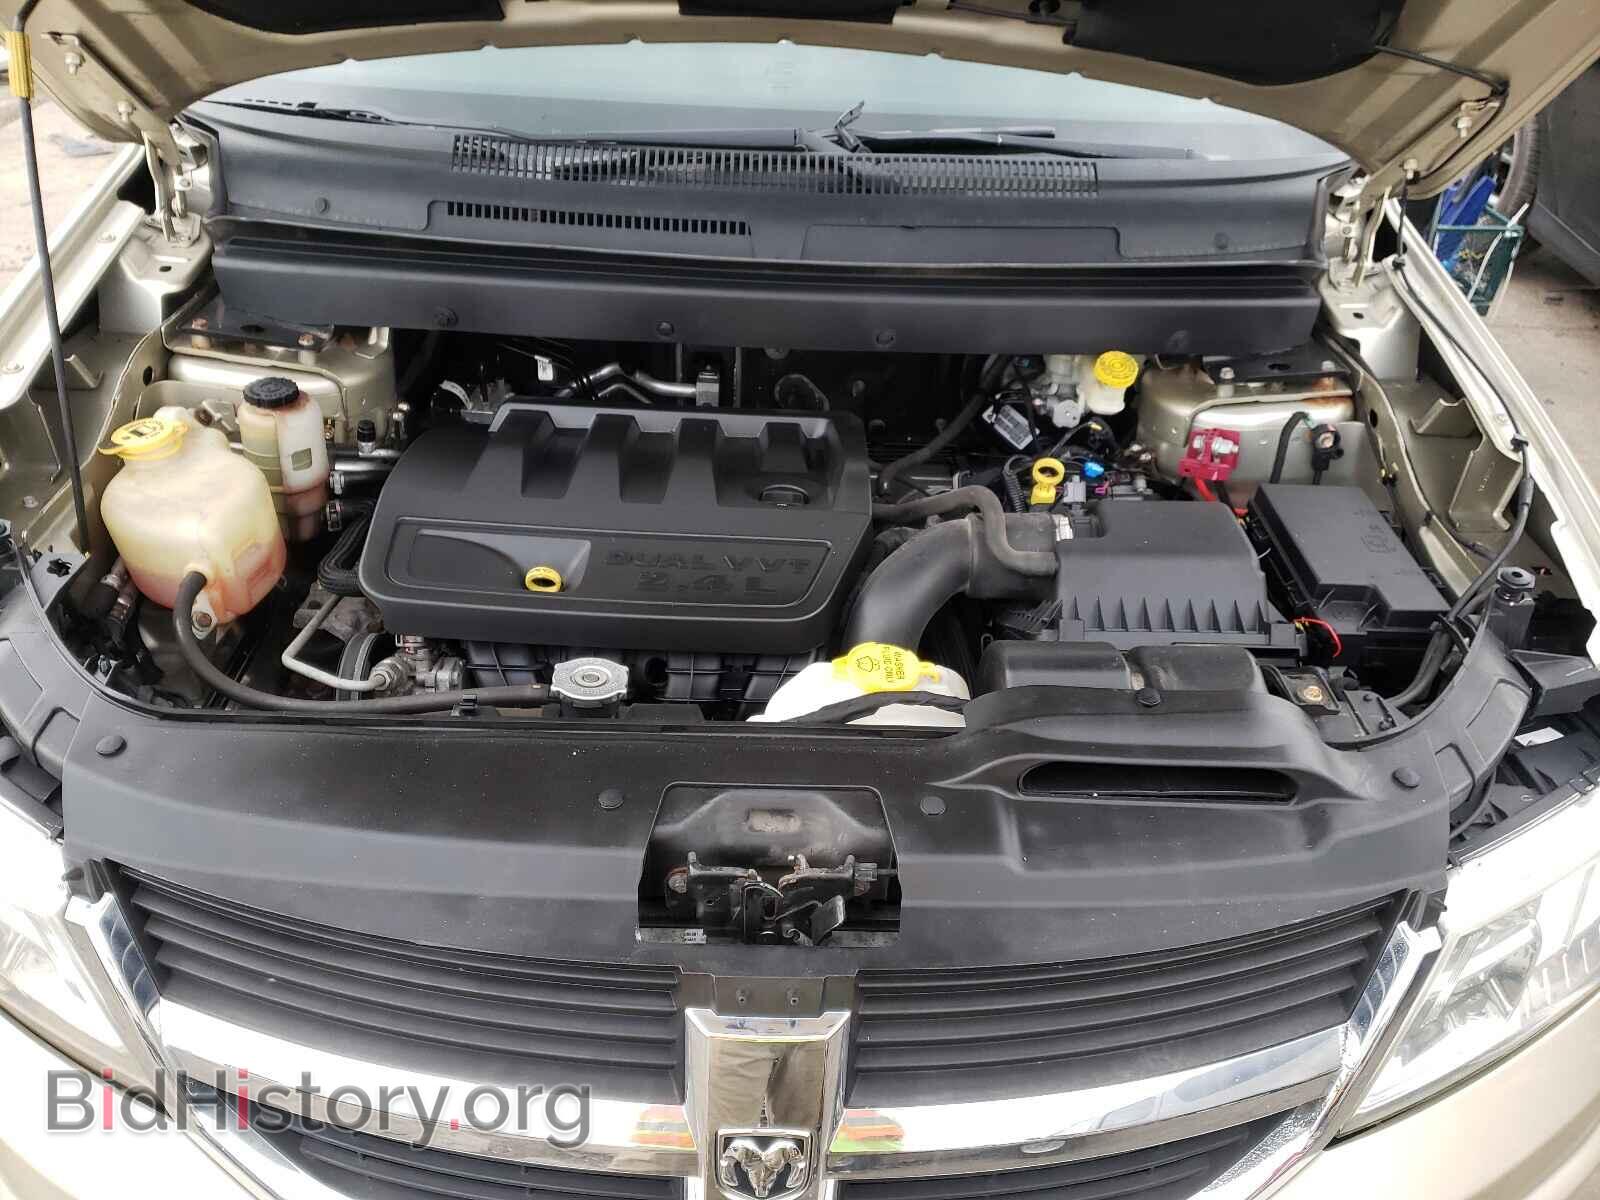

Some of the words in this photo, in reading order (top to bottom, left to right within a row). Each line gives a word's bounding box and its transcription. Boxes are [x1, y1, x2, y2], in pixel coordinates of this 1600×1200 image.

[604, 550, 718, 570] DUAL
[635, 570, 778, 595] 2.4L
[894, 651, 905, 680] WASHER
